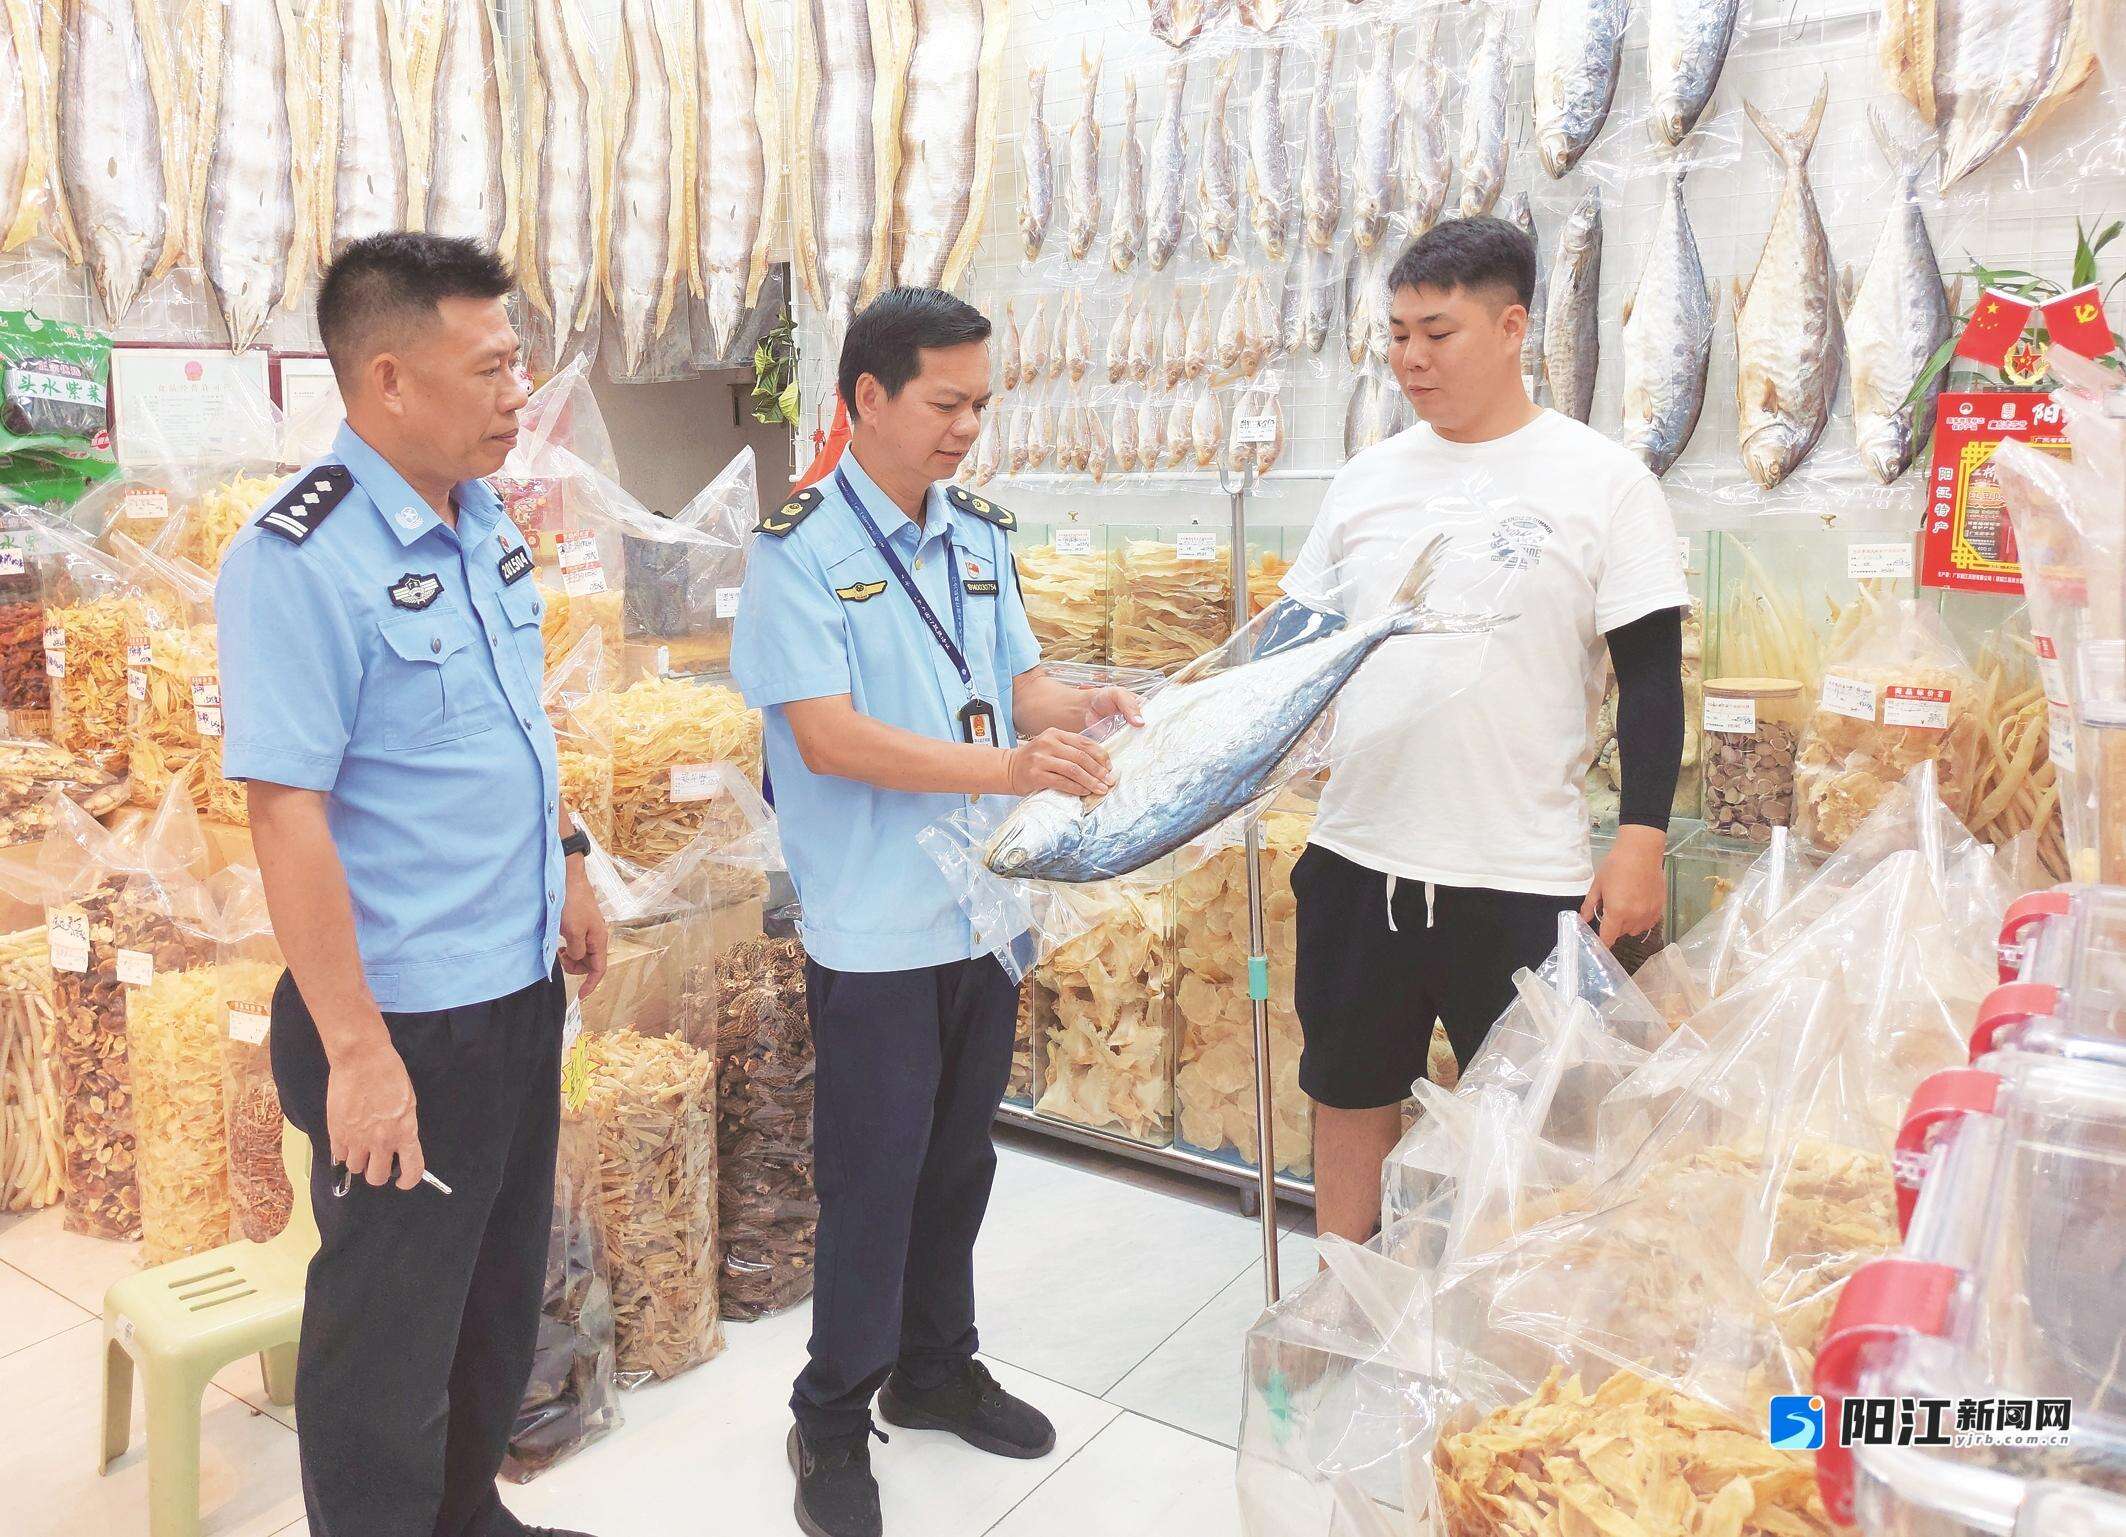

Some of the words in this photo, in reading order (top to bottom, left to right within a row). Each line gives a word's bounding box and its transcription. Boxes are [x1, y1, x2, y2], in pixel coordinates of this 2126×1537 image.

[18, 374, 104, 403] 头水紫菜
[1932, 467, 1953, 534] 阳江特产
[502, 552, 529, 579] 201504
